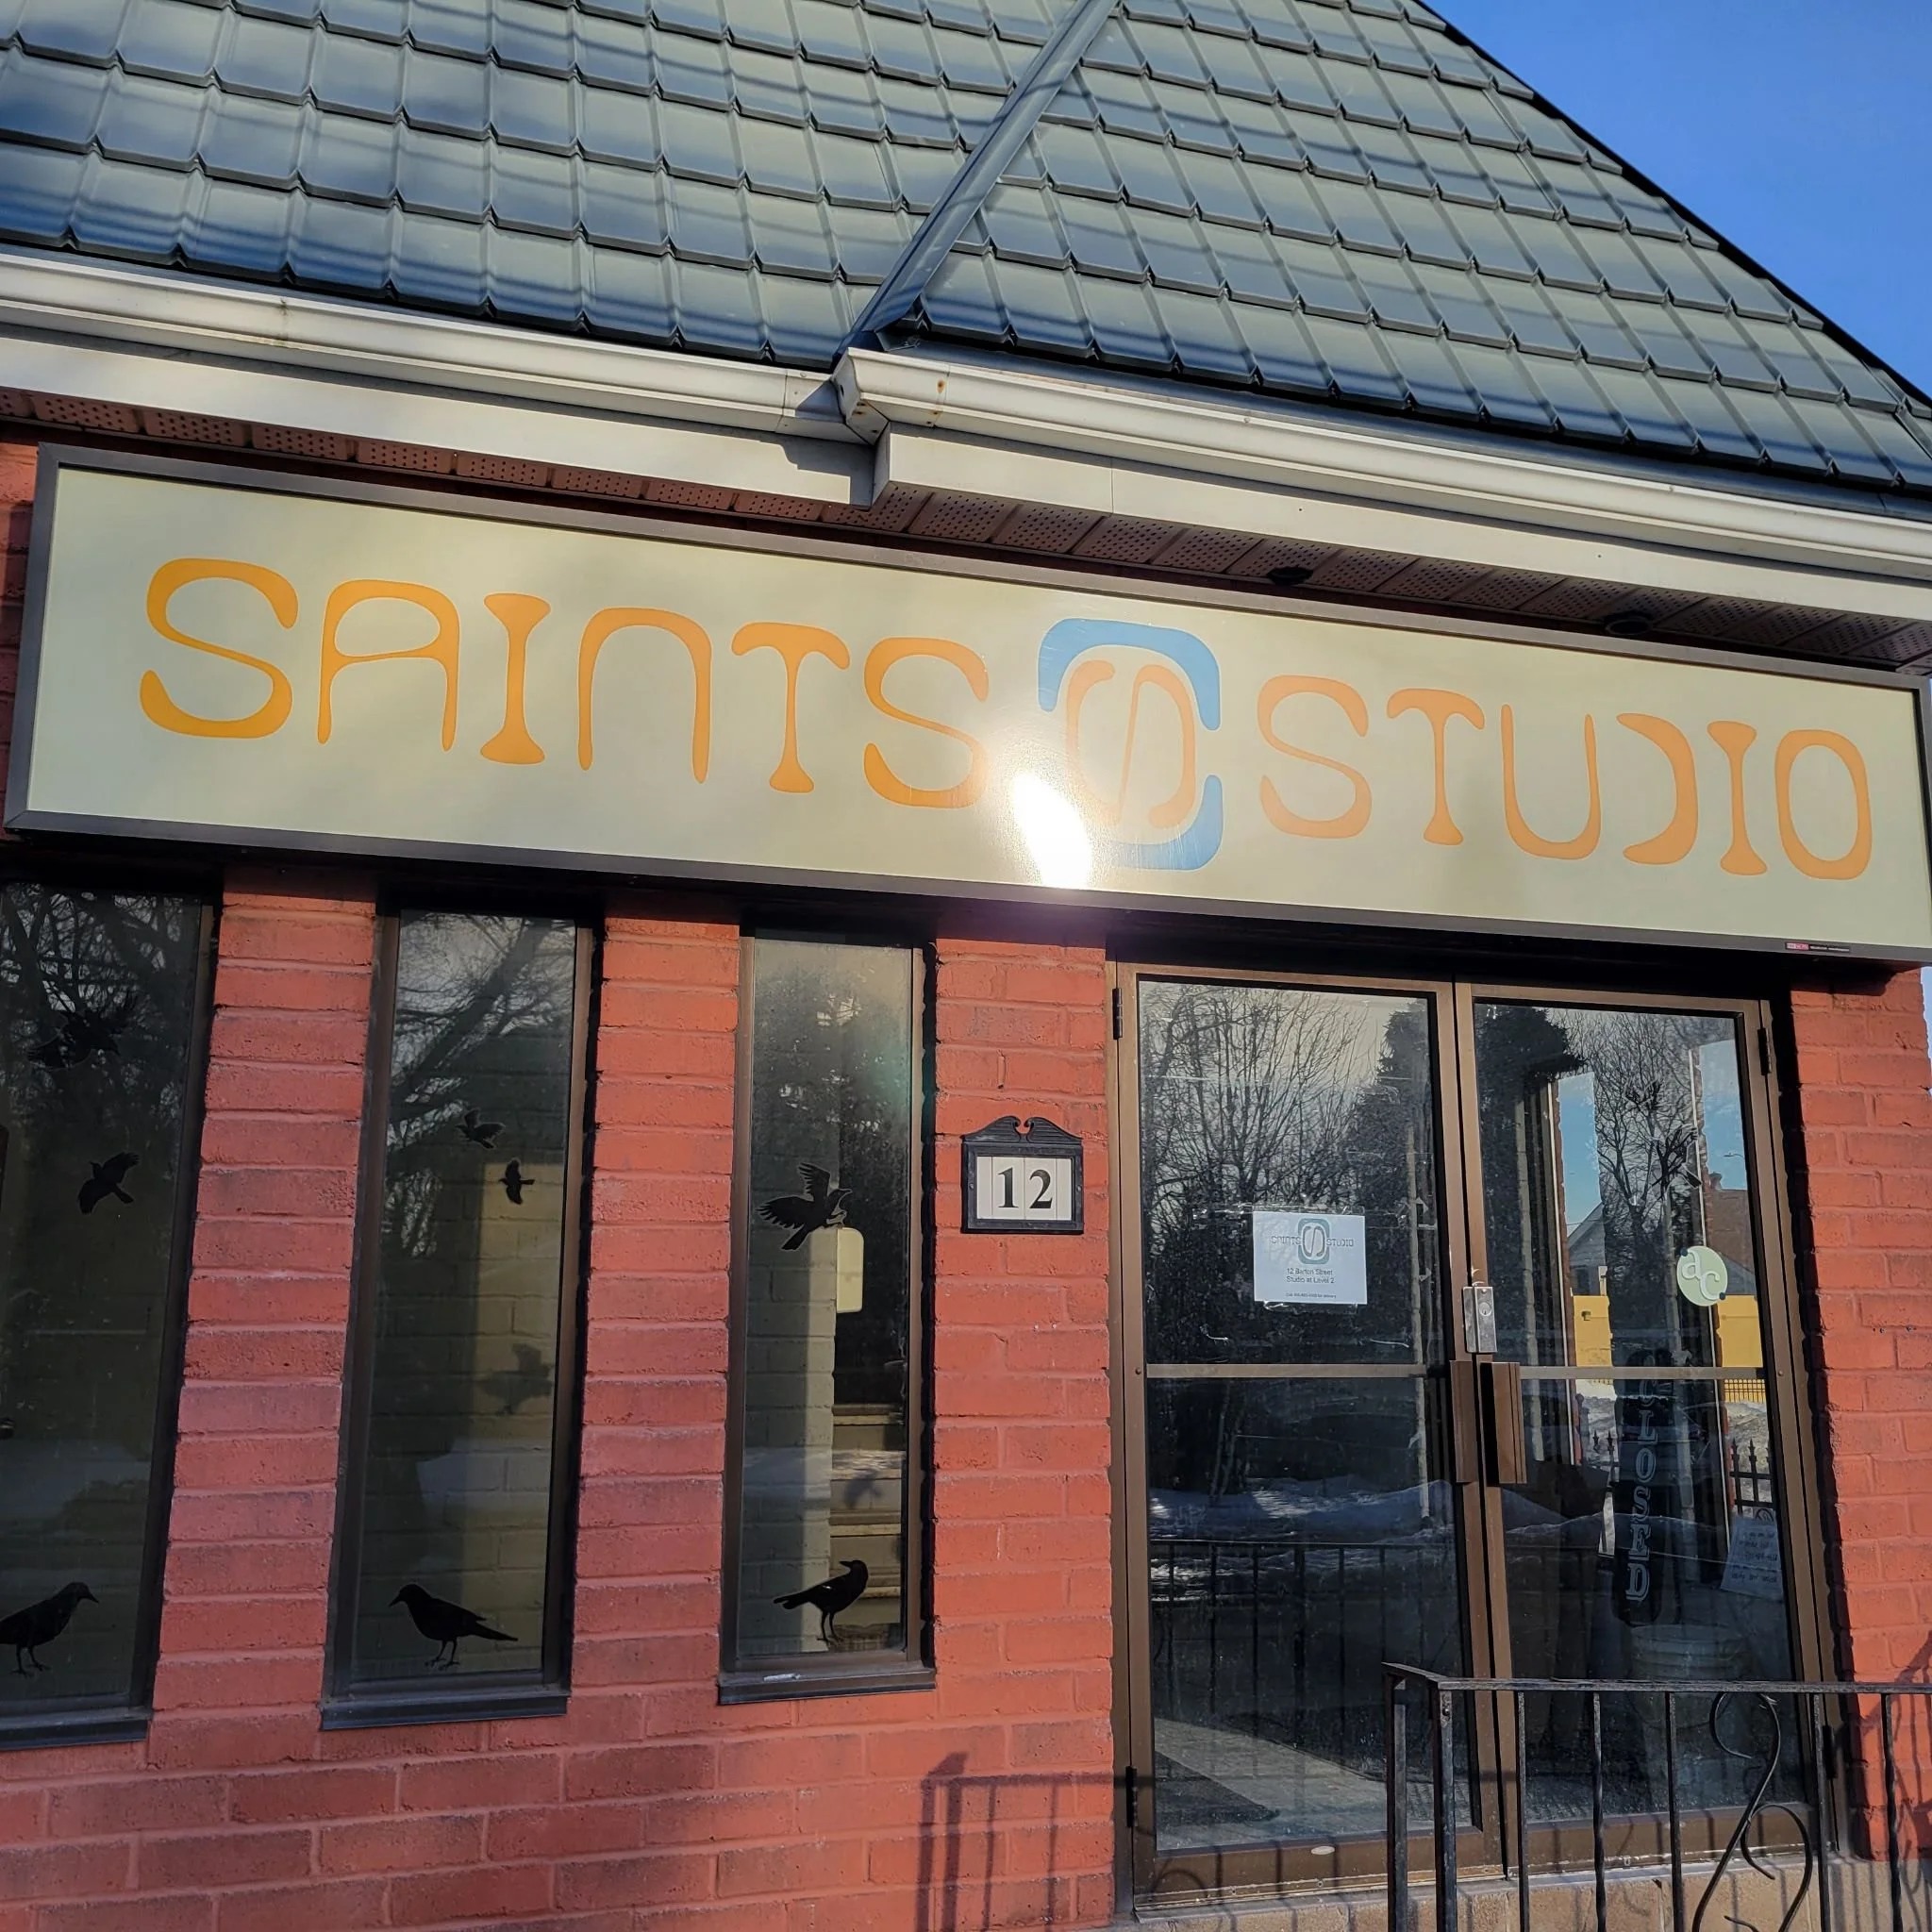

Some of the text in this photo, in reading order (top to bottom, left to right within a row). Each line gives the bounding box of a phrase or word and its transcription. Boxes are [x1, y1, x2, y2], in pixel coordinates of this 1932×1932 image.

[140, 558, 1873, 881] SAINTS STUDIO
[998, 1167, 1053, 1208] 12
[1326, 1238, 1354, 1247] STUDIO
[1625, 1379, 1658, 1602] CLOSED
